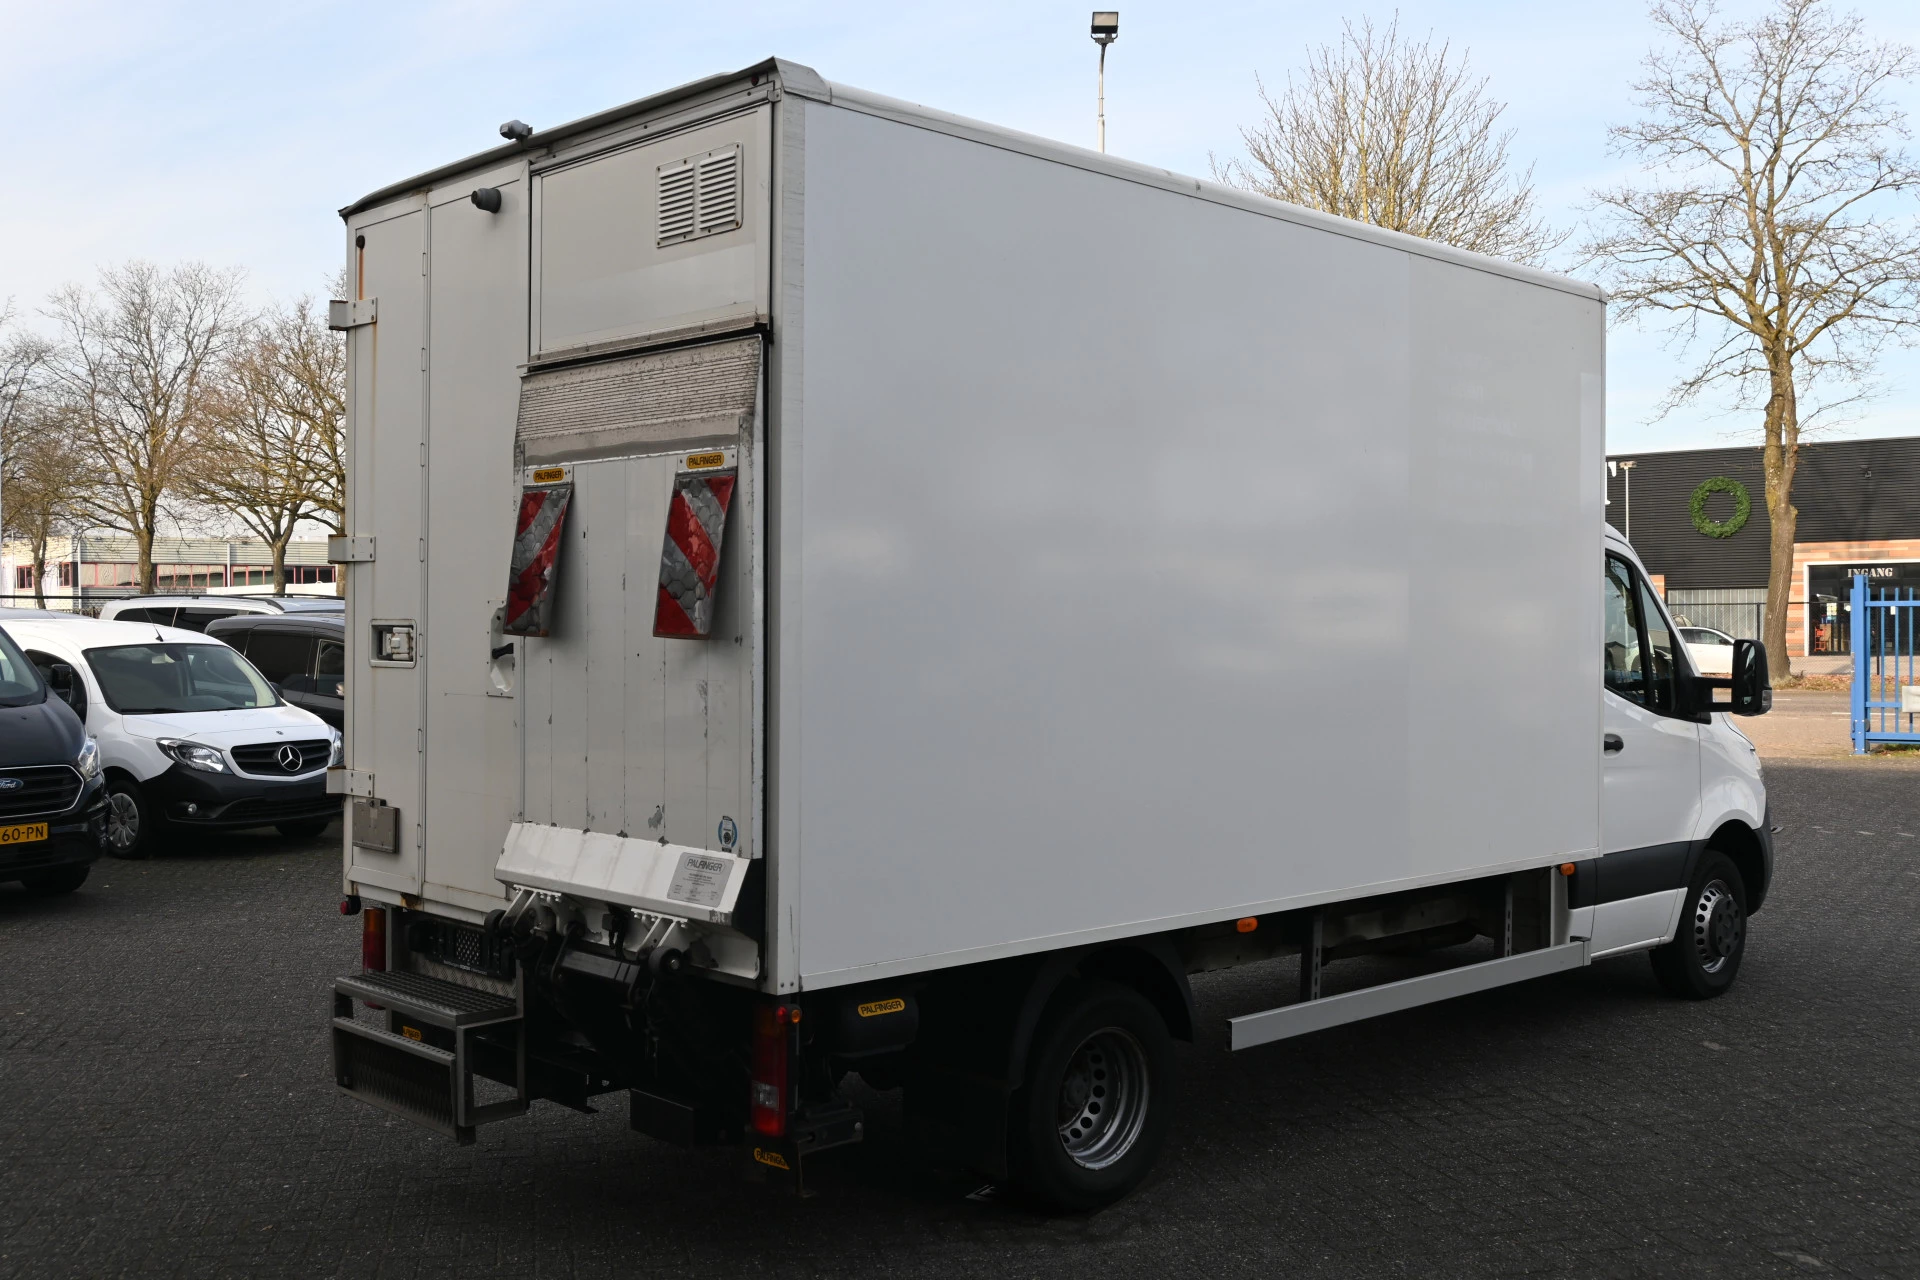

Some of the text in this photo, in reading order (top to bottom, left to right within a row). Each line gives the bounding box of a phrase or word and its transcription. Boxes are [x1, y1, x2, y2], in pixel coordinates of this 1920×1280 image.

[688, 454, 722, 466] PALFINGER
[535, 470, 562, 480] PALFINGER
[1847, 567, 1893, 578] INGANG
[0, 780, 16, 789] Ford
[2, 825, 44, 842] 60-PN
[687, 858, 723, 872] PALFINGER
[860, 1000, 903, 1015] PALFINGER
